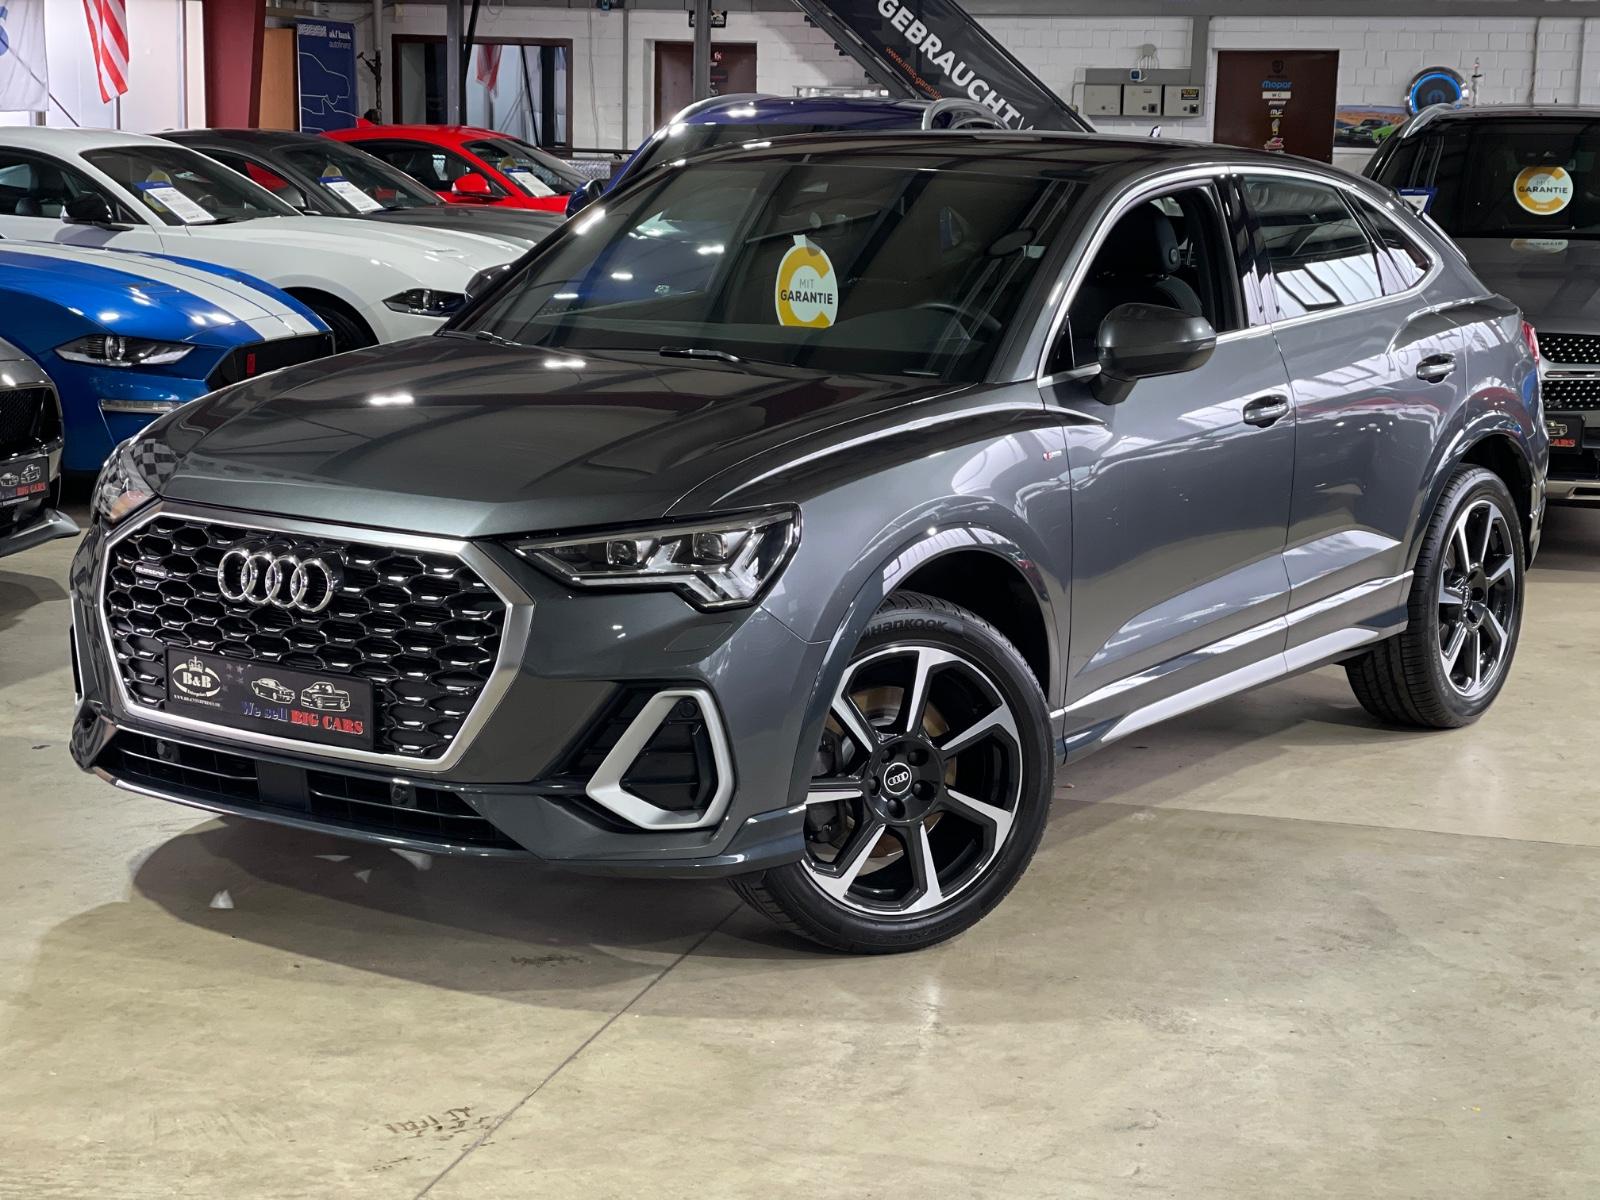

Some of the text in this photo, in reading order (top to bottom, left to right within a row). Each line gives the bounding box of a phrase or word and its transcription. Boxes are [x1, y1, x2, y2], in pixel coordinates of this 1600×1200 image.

[1518, 185, 1568, 194] GARANTIE
[799, 278, 815, 289] MIT
[780, 289, 833, 304] GARANTIE
[182, 671, 211, 688] B&B
[242, 701, 364, 735] We sell BIG CARS
